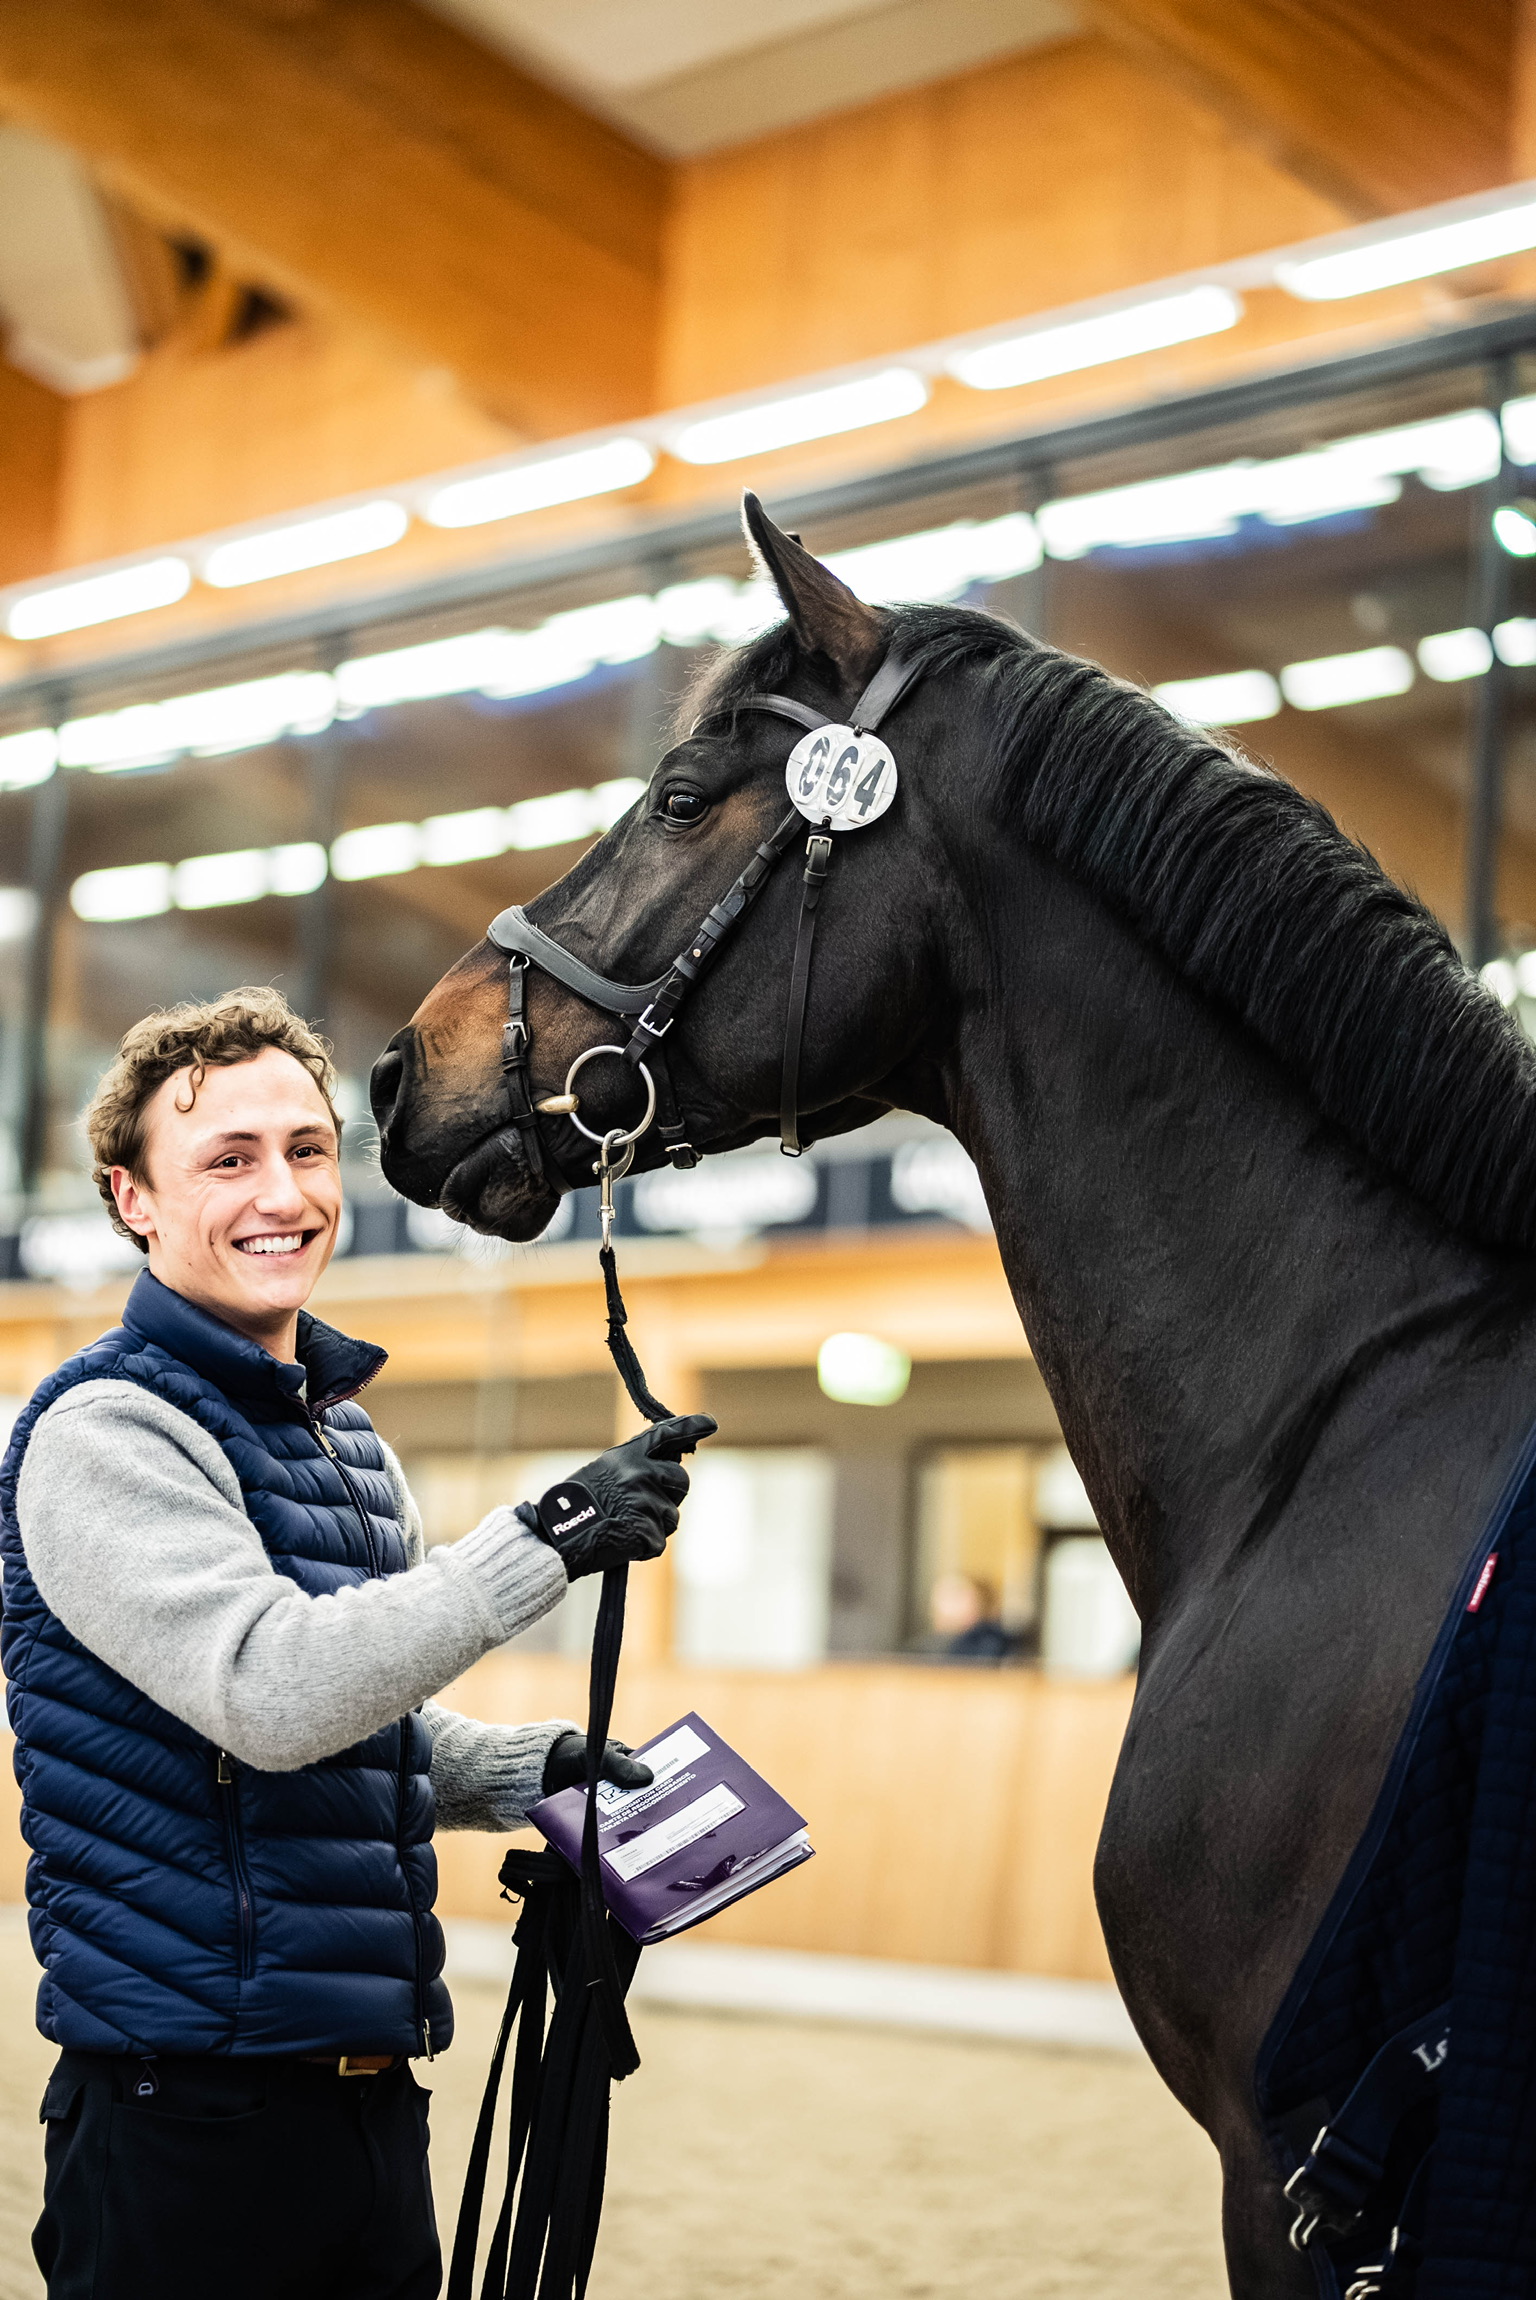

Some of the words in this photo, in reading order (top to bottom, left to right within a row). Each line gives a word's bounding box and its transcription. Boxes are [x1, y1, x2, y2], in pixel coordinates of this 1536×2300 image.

[552, 1505, 596, 1535] Roeckl
[599, 1813, 622, 1829] CARTE
[621, 1808, 632, 1817] DE
[631, 1772, 691, 1811] RECONNAISSANCE
[599, 1815, 630, 1833] TARJETA
[628, 1810, 639, 1818] DE
[638, 1773, 697, 1813] RECONOCIMIENTO
[610, 1789, 655, 1817] RECOGNITION
[655, 1777, 674, 1791] CARD
